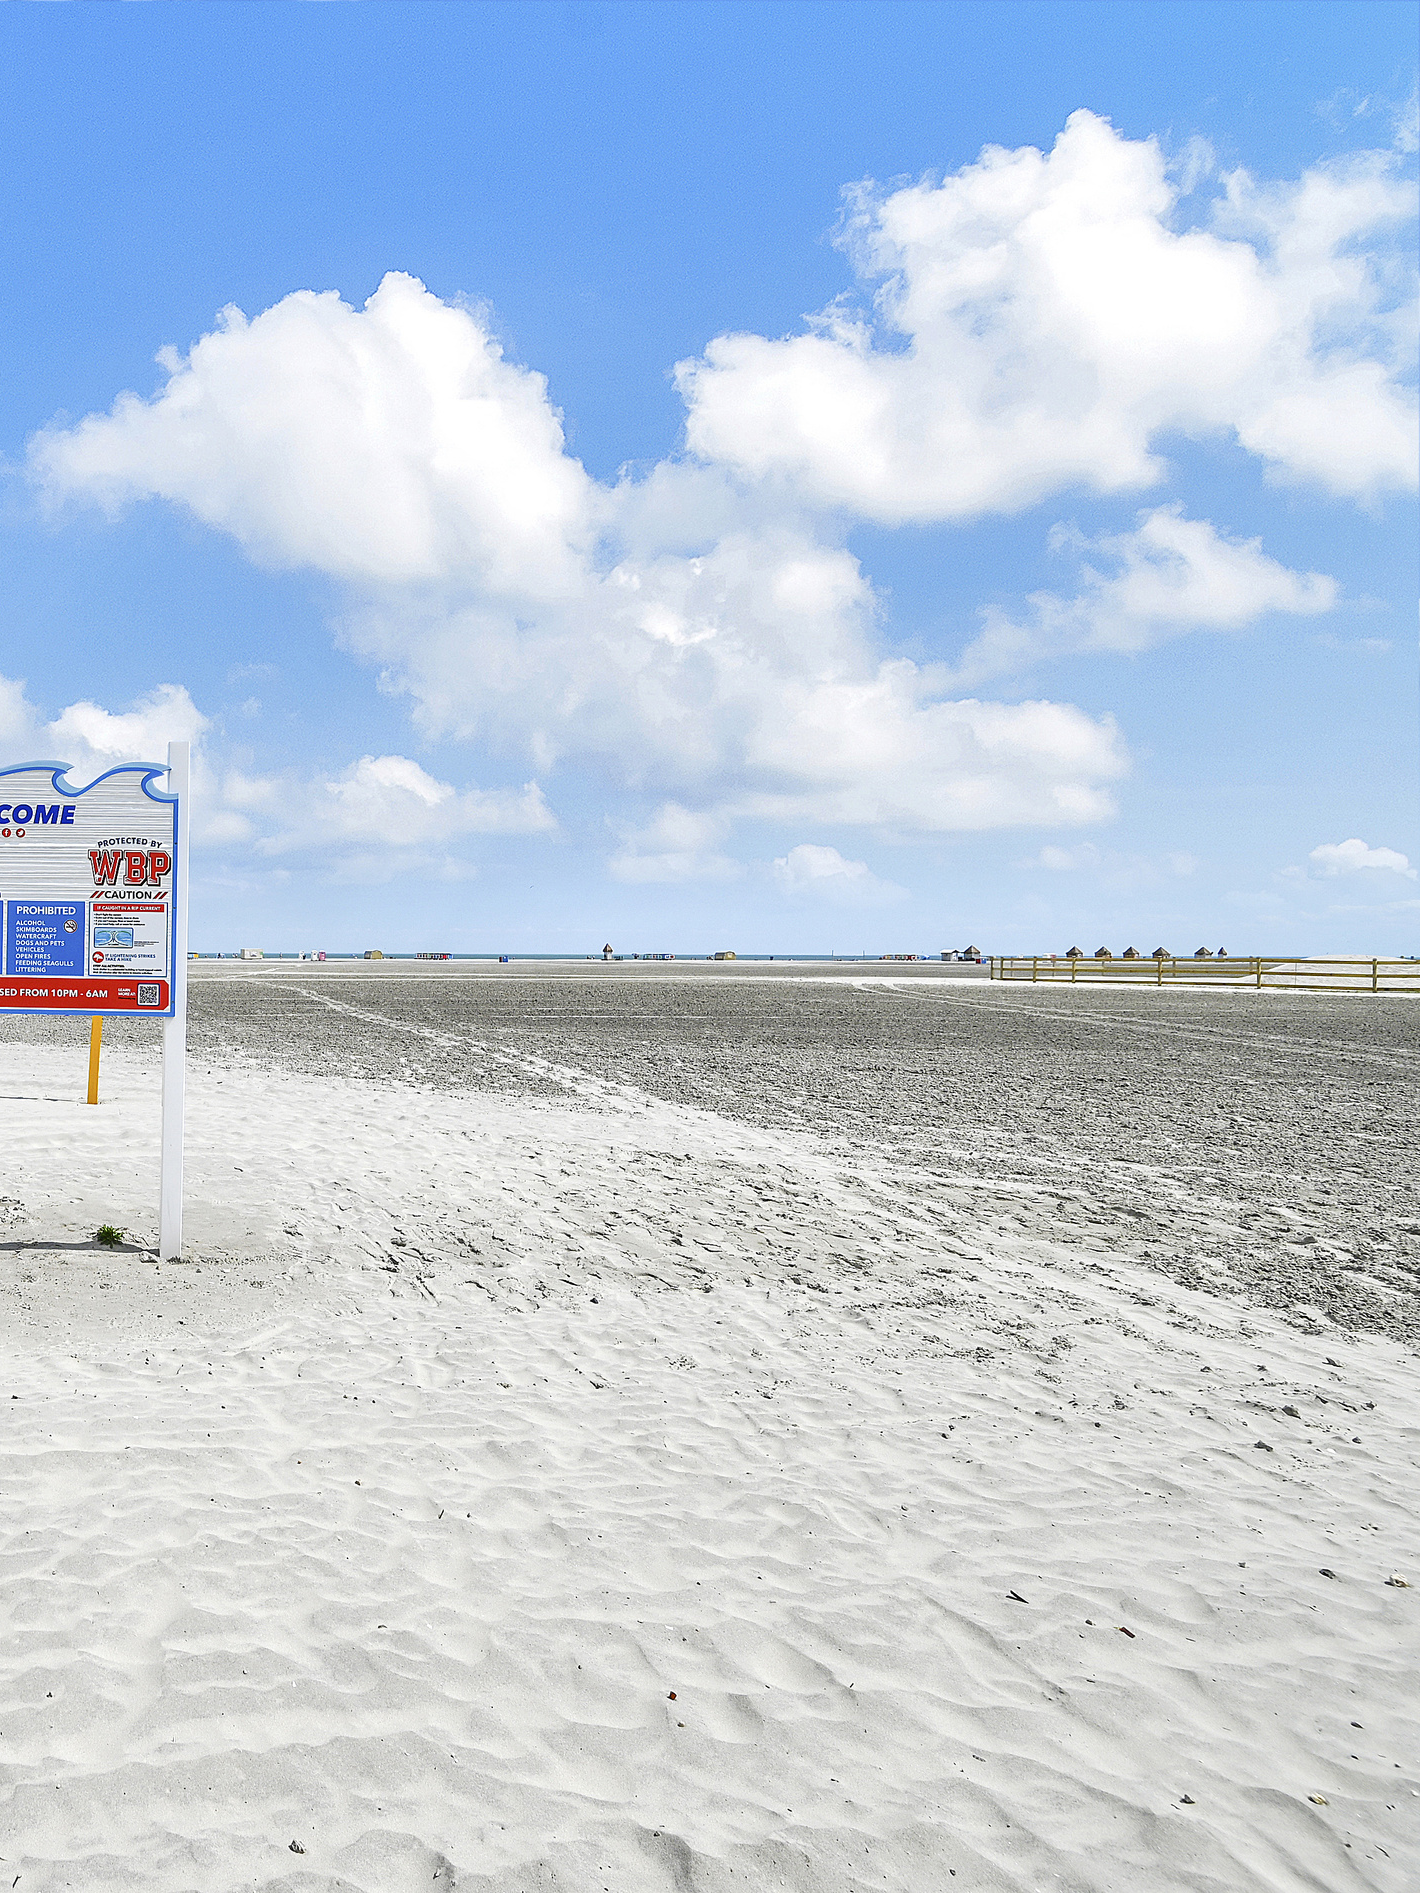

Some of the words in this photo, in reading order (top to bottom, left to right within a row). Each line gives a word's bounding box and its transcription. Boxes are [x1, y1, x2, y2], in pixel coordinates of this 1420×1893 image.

[98, 837, 148, 848] PROTECTED
[150, 840, 162, 848] BY
[88, 849, 171, 887] WBP
[104, 891, 152, 899] CAUTION
[16, 906, 76, 915] PROHIBITED
[19, 988, 48, 997] FROM
[51, 989, 78, 997] 10PM
[85, 989, 108, 998] 6AM
